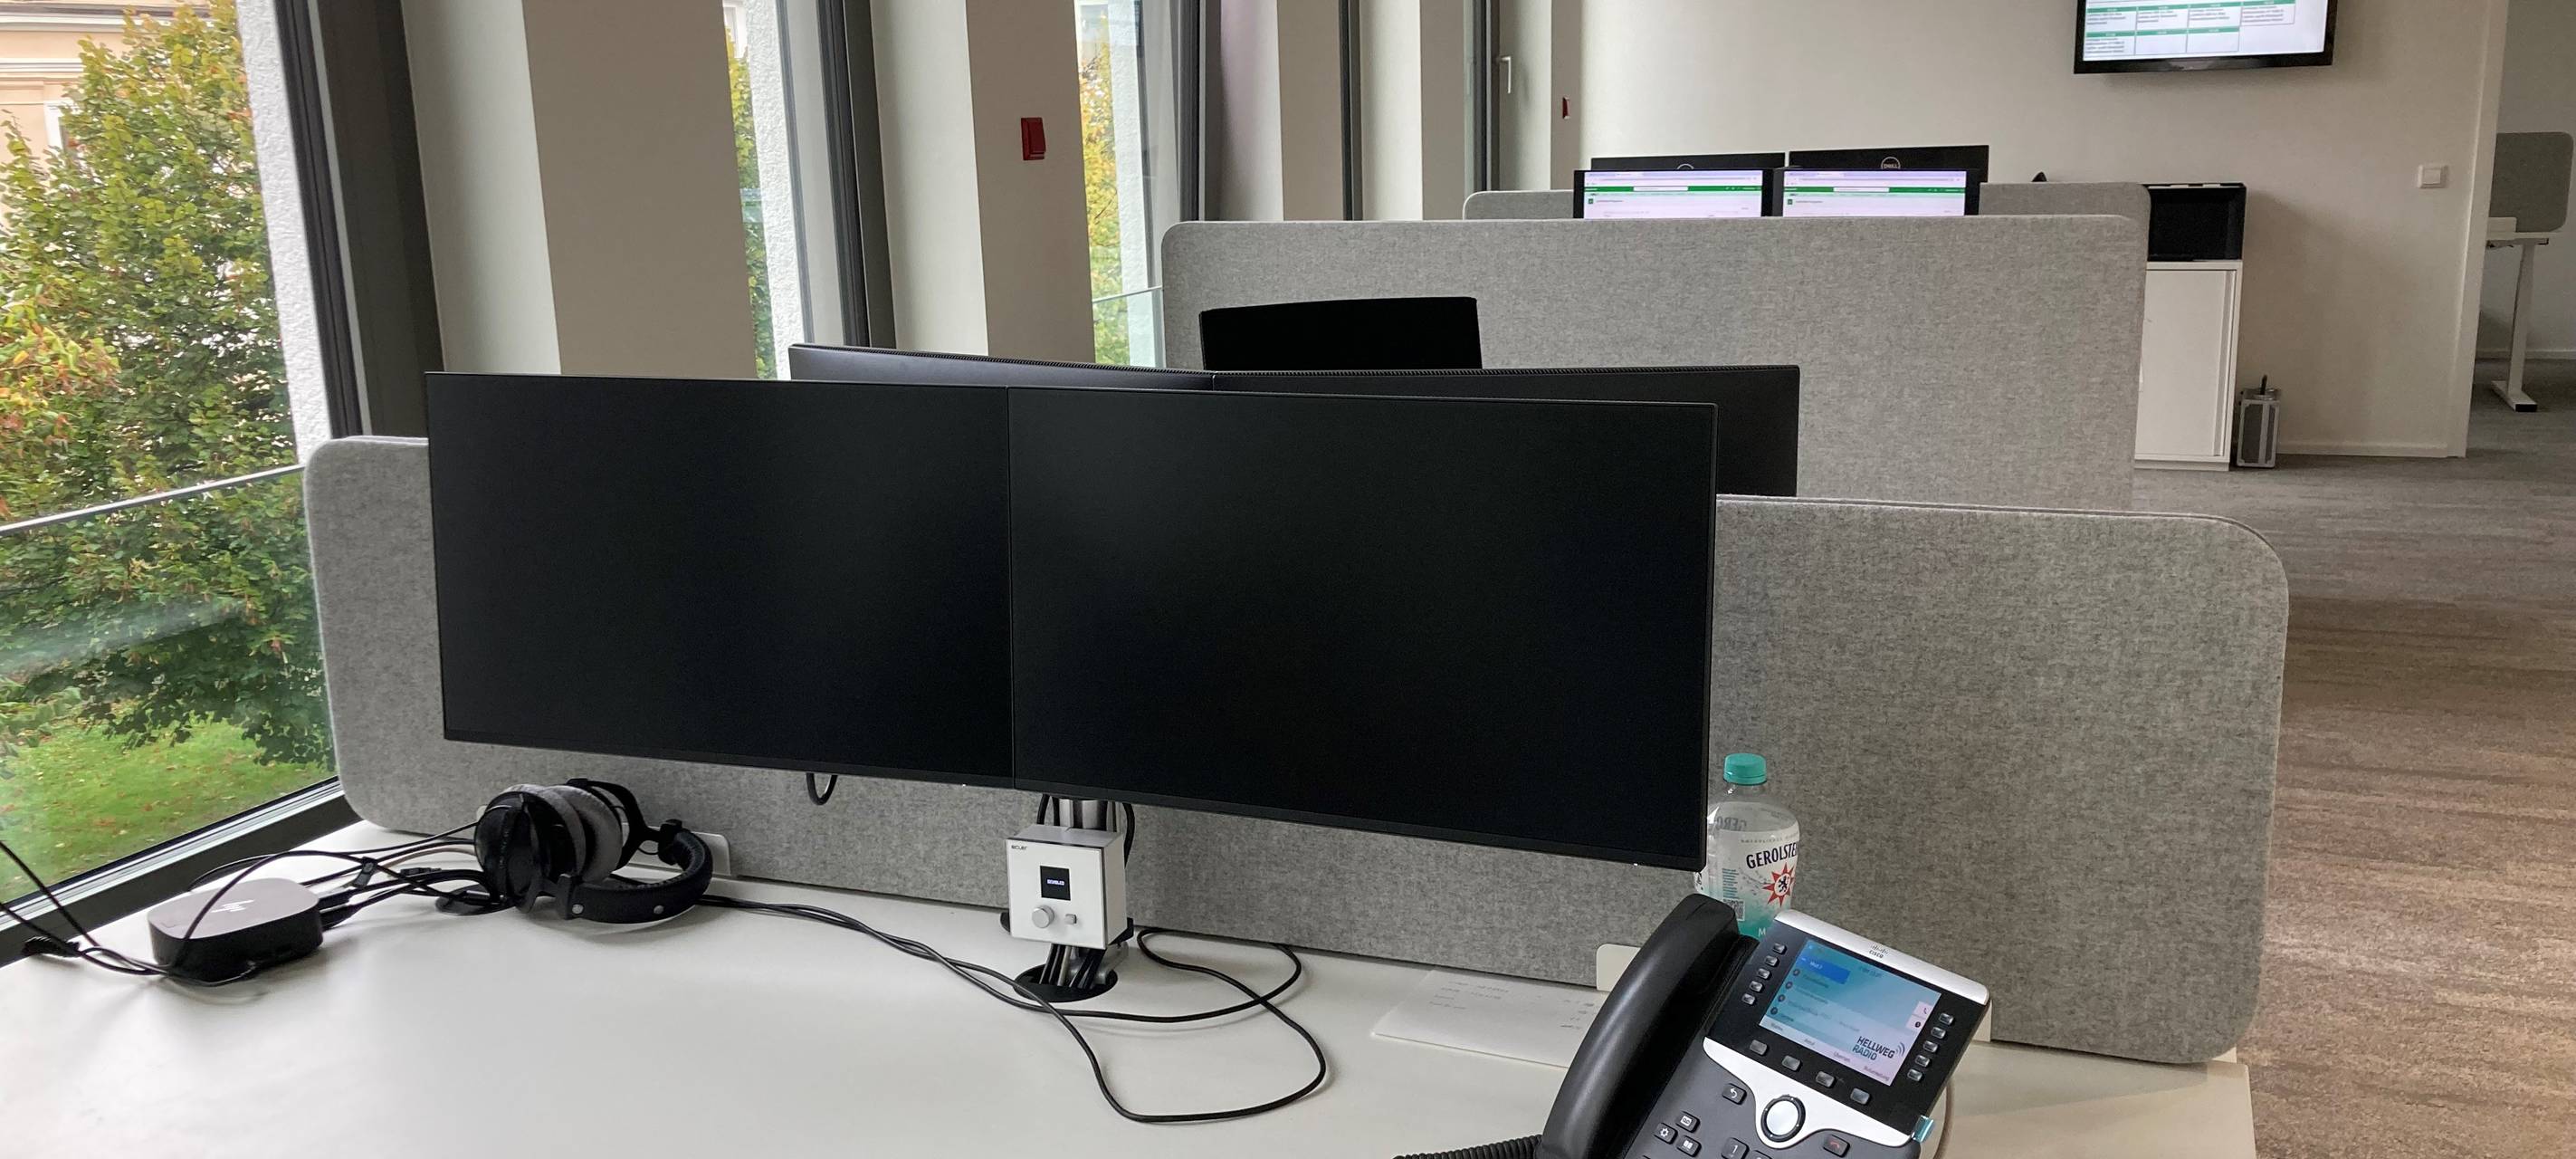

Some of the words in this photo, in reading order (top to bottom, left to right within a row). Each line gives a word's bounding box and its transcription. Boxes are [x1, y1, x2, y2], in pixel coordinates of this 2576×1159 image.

[1852, 1044, 1878, 1061] RADIO
[1856, 1035, 1896, 1059] HELLWEG
[1732, 1145, 1739, 1154] 1
